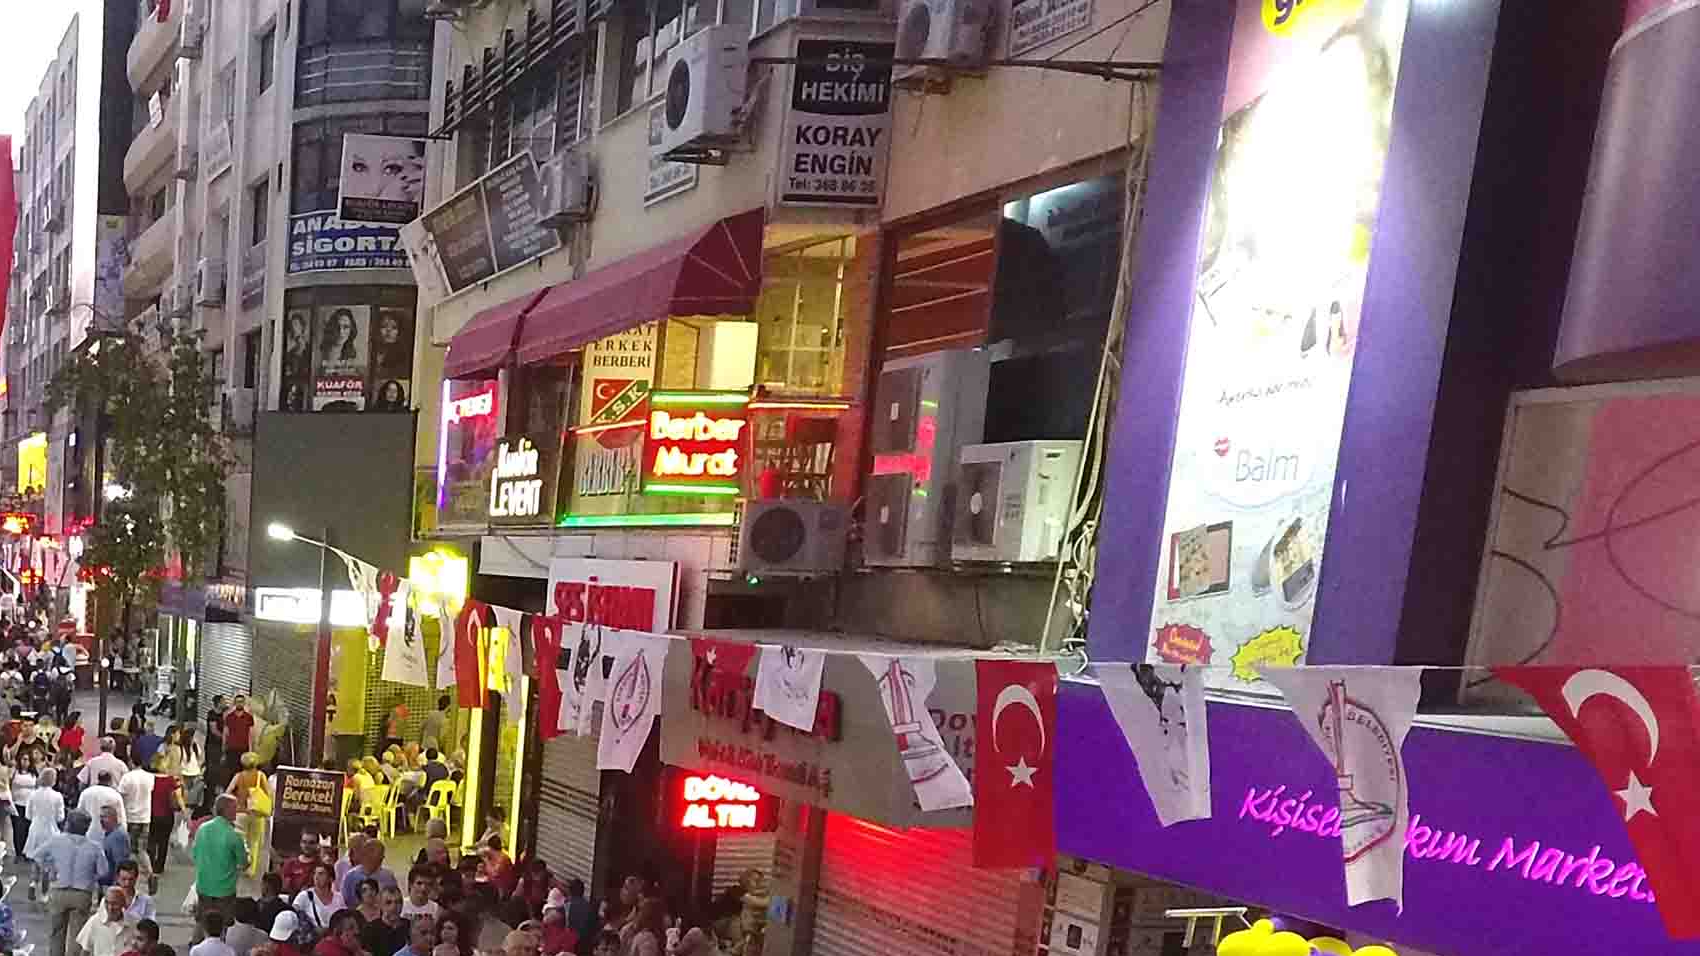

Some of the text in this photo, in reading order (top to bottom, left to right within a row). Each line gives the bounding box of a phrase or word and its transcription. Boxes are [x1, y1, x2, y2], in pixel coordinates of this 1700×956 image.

[801, 78, 885, 103] HEKİMİ
[795, 125, 883, 157] KORAY
[794, 162, 873, 186] ENGİN
[594, 339, 653, 351] ERKEK
[593, 355, 650, 368] BERBERİ
[316, 380, 363, 390] KUAFÖR
[652, 411, 746, 441] Berber
[653, 446, 739, 476] Murat
[1235, 449, 1300, 482] Balm
[489, 467, 542, 517] LEVENT
